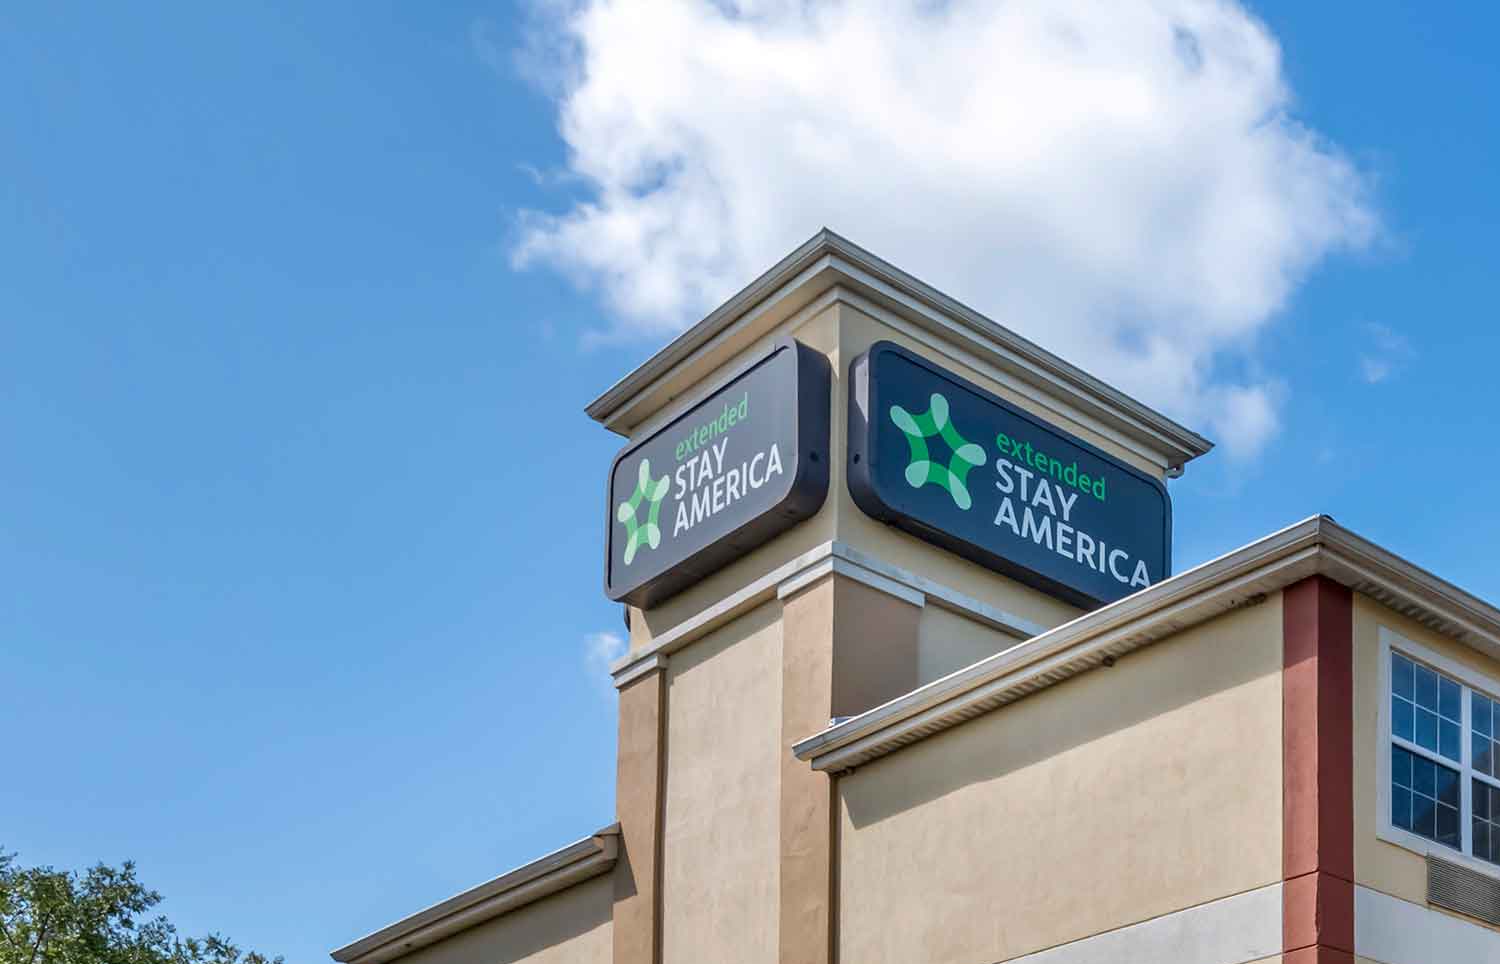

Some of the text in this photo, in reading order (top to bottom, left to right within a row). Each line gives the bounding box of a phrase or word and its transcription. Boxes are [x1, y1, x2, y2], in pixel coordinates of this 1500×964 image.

[676, 392, 748, 461] extended
[673, 443, 783, 538] AMERICA
[674, 437, 728, 500] STAY
[995, 458, 1079, 521] STAY
[996, 432, 1106, 501] extended
[993, 497, 1151, 588] AMERICA
